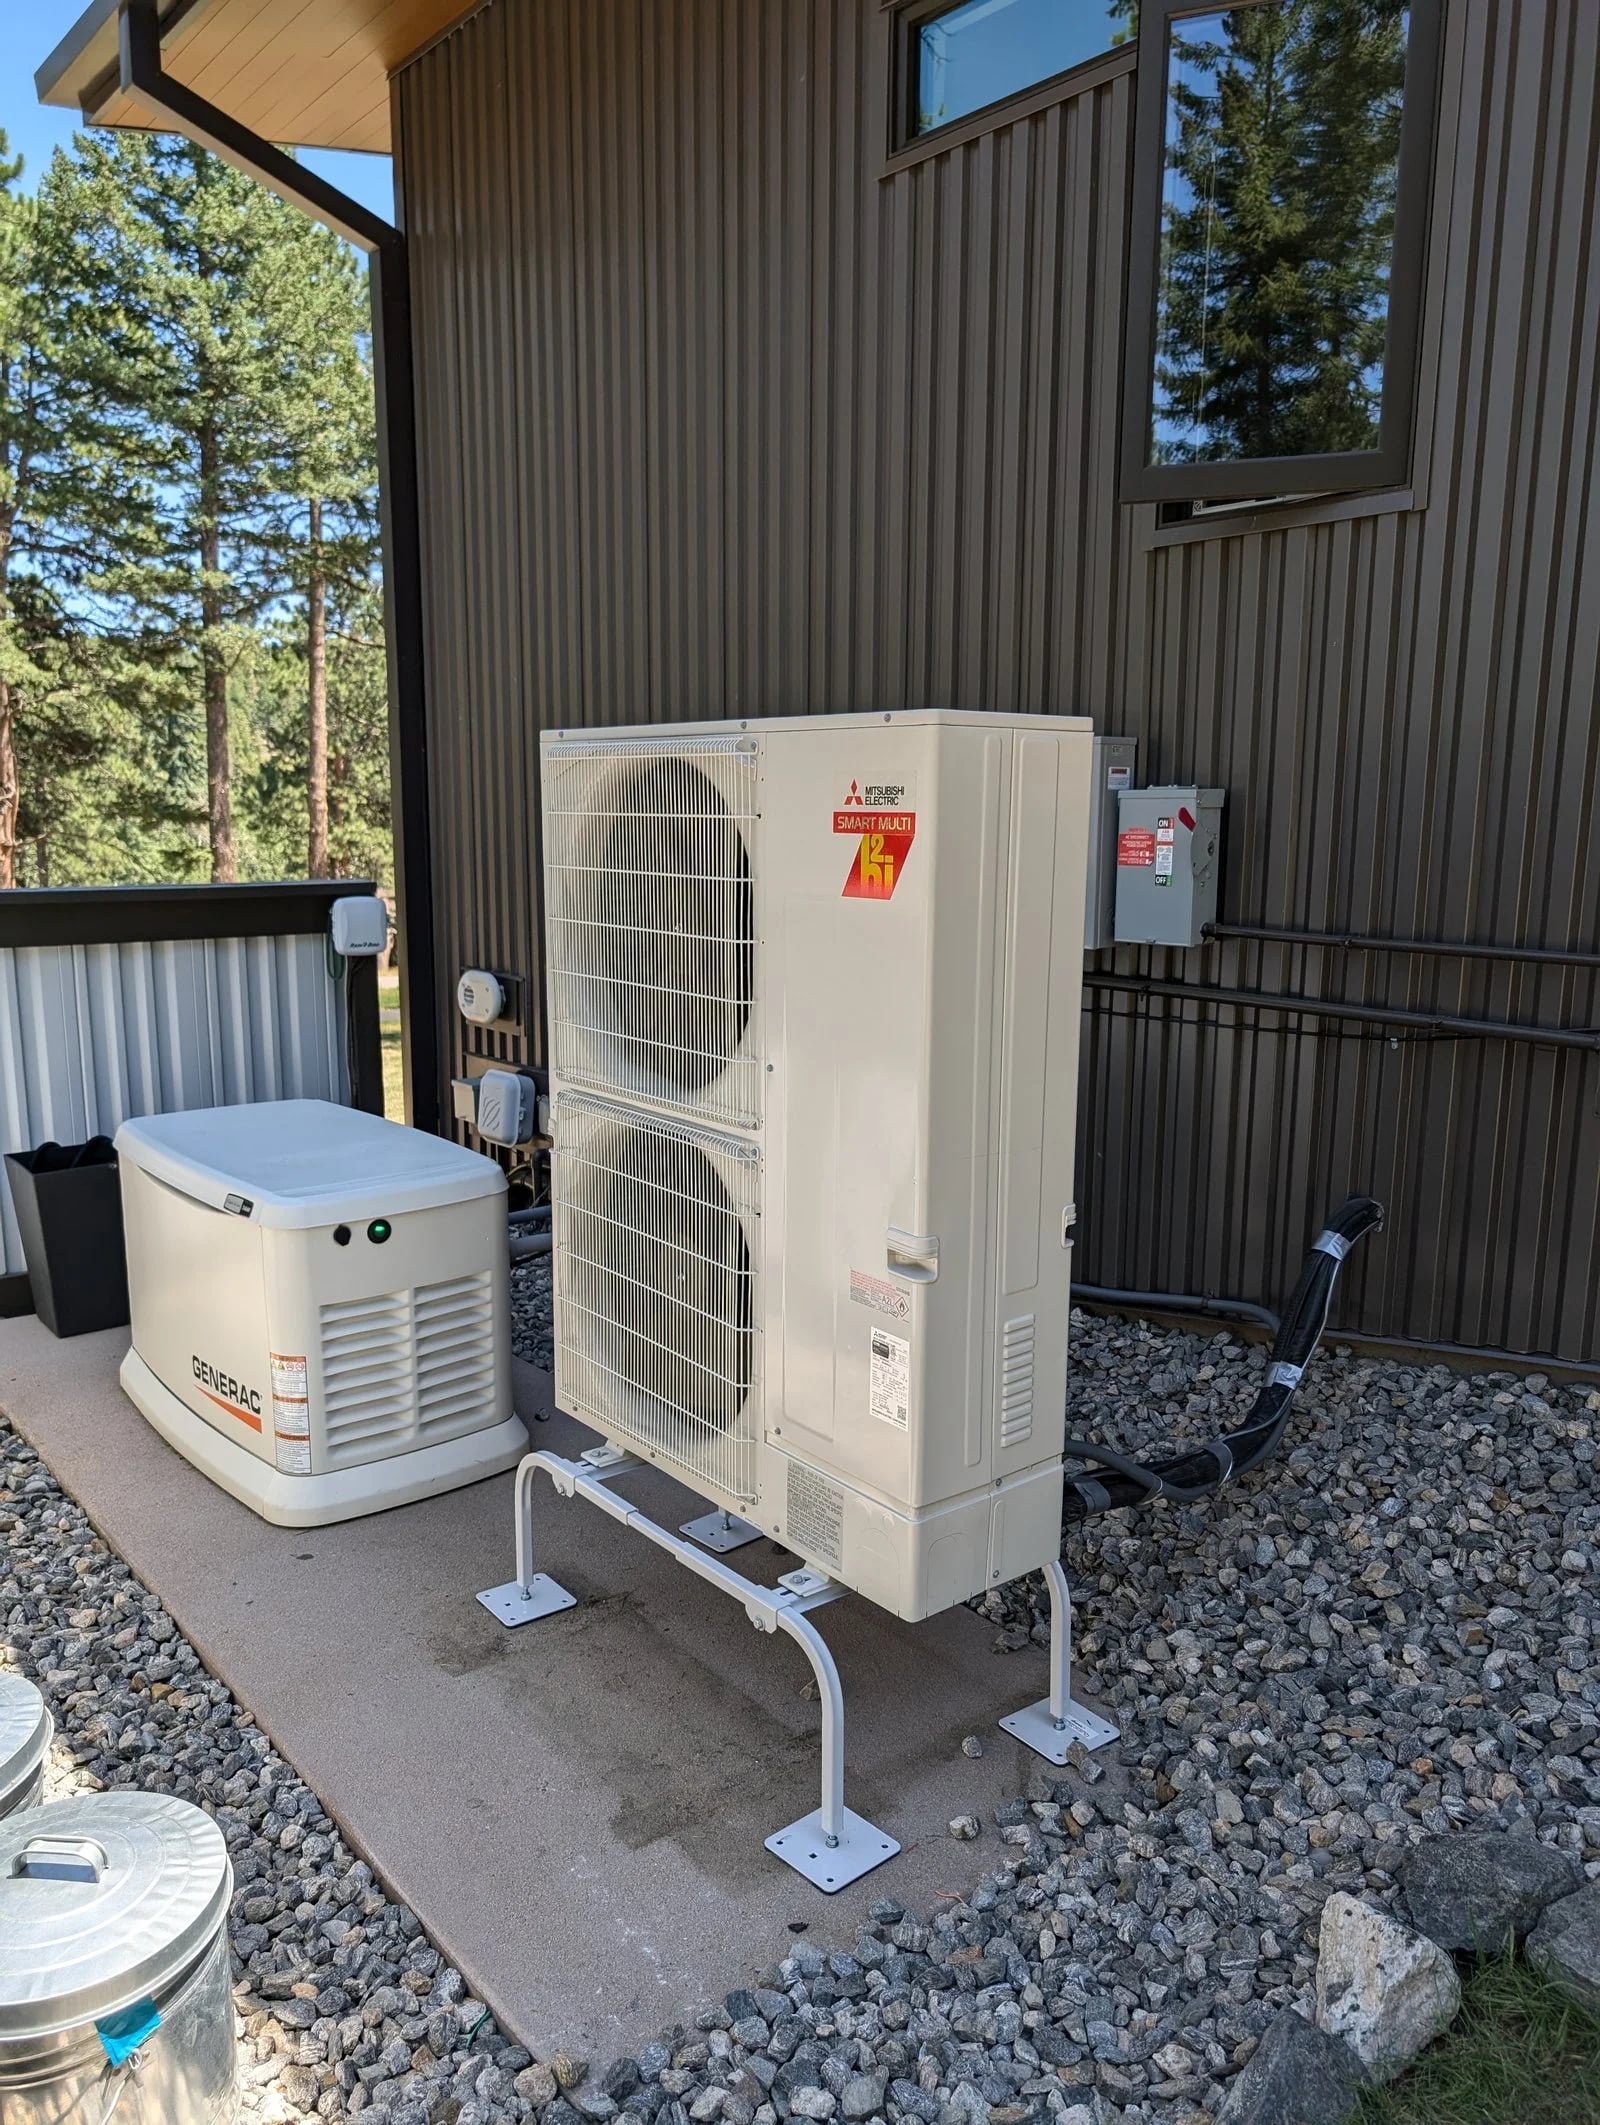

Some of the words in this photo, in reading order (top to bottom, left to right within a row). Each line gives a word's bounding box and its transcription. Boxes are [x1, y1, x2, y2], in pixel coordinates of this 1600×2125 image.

[865, 786, 905, 796] MITSUBISHI
[865, 796, 899, 806] ELECTRIC
[837, 816, 876, 830] SMART
[878, 816, 911, 831] MULTI
[192, 1354, 261, 1415] GENERAC
